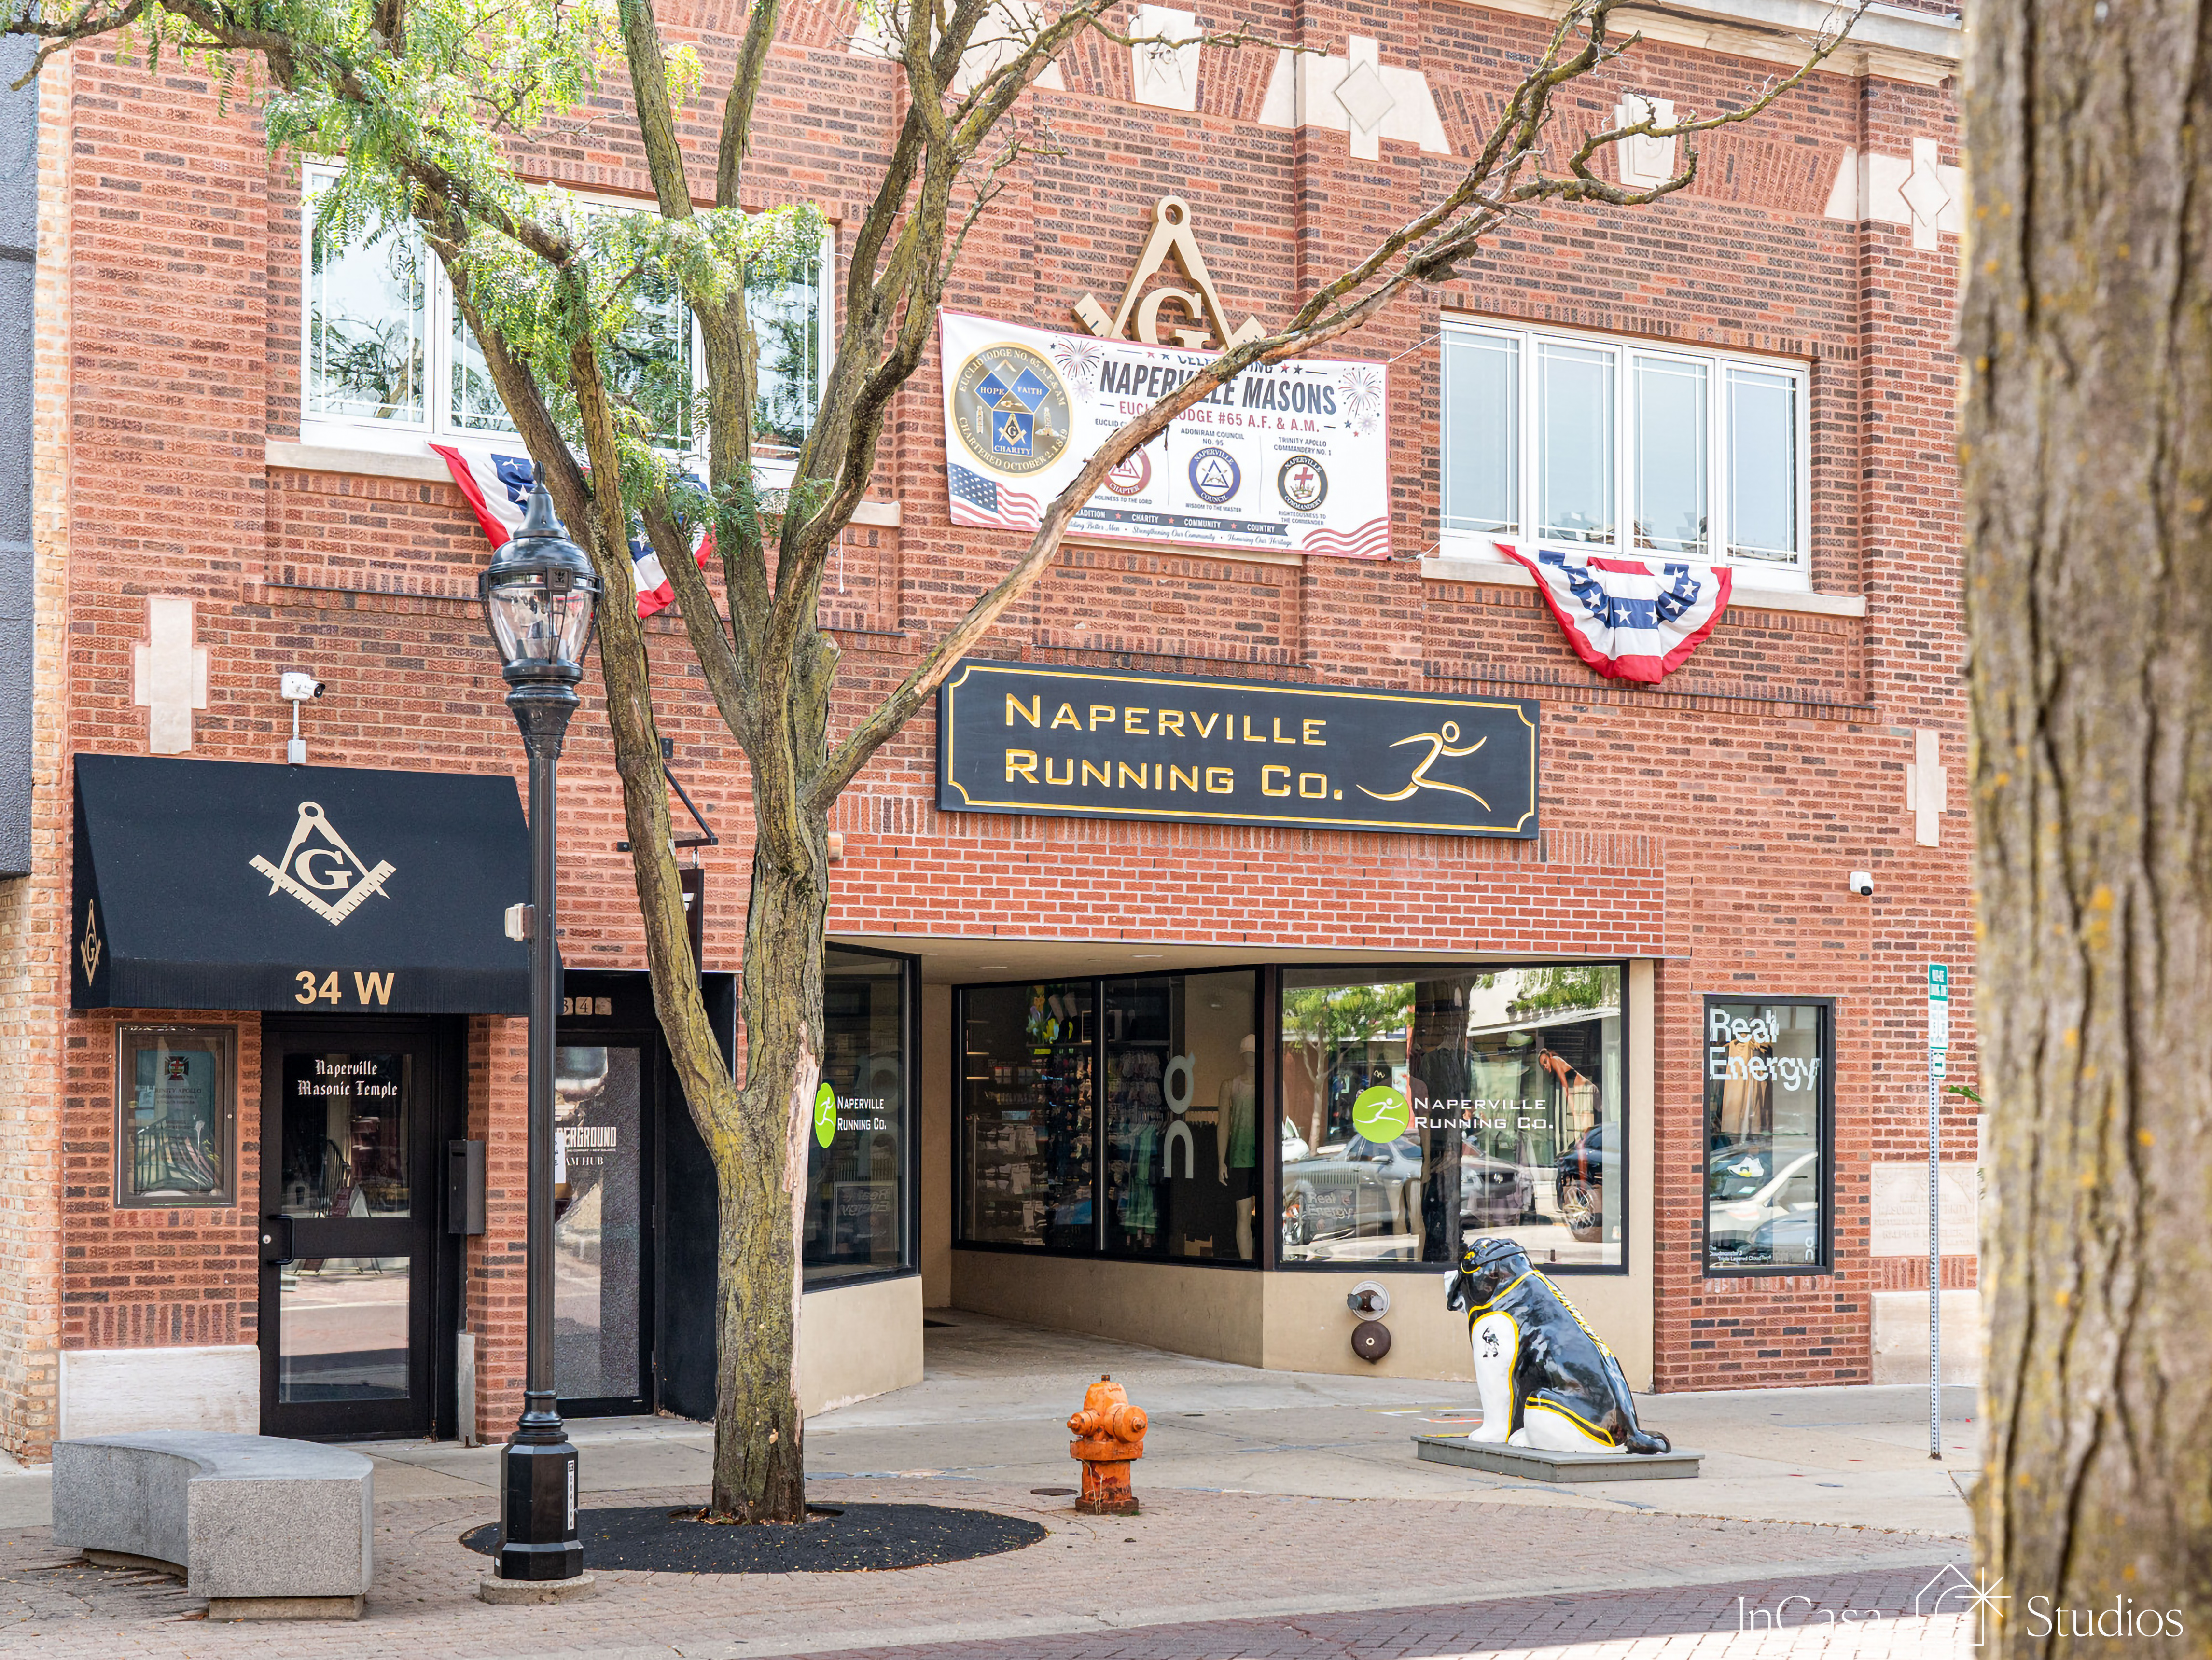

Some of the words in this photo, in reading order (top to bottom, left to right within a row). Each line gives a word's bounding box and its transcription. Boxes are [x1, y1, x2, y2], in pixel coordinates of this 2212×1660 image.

[1132, 287, 1210, 349] G
[959, 358, 984, 392] EUCLID
[983, 349, 1012, 361] LODGE
[1014, 350, 1028, 361] NO.
[980, 387, 1005, 395] HOPE
[1017, 386, 1042, 395] FAITH
[1242, 377, 1336, 415] MASONS
[1095, 418, 1119, 427] EUCLID
[1120, 401, 1148, 415] EUC
[1175, 408, 1213, 423] ODGE
[1219, 412, 1242, 426] #65
[1248, 415, 1271, 429] A.F.
[1277, 417, 1285, 429] &
[1291, 418, 1320, 432] A.M.
[1007, 426, 1017, 436] G
[1181, 428, 1215, 437] ADONIRAM
[1216, 431, 1244, 440] COUNCIL
[960, 417, 1002, 466] CHARTERED
[1004, 456, 1046, 470] OCTOBER
[1052, 429, 1068, 451] 1849
[1279, 436, 1303, 444] TRINITY
[1305, 439, 1326, 447] APOLLO
[994, 445, 1031, 455] CHARITY
[1274, 444, 1315, 454] COMMANDERY
[1194, 449, 1234, 465] NAPERVILLE
[1284, 456, 1322, 473] NAPERVILLE
[1109, 483, 1140, 494] CHAPTER
[1200, 492, 1229, 503] COUNCIL
[1284, 495, 1322, 510] COMMANDERY
[1076, 509, 1105, 518] ADITION
[1132, 514, 1159, 523] CHARITY
[1184, 518, 1221, 528] COMMUNITY
[1247, 524, 1275, 533] COUNTRY
[1005, 693, 1327, 747] NAPERVILLE
[1005, 749, 1235, 795] RUNNING
[1261, 765, 1344, 801] CO.
[294, 848, 353, 890] G
[294, 971, 342, 1005] 34
[354, 971, 395, 1005] W
[1710, 1008, 1780, 1043] Real
[315, 1059, 377, 1078] Naperville
[1710, 1047, 1820, 1091] Energy
[297, 1080, 350, 1095] Masonic
[355, 1080, 398, 1099] Temple
[837, 1096, 884, 1109] NAPERVILLE
[1414, 1097, 1546, 1110] NAPERVILLE
[837, 1117, 871, 1131] RUNNING
[1414, 1116, 1507, 1130] RUNNING
[582, 1157, 604, 1166] HUB
